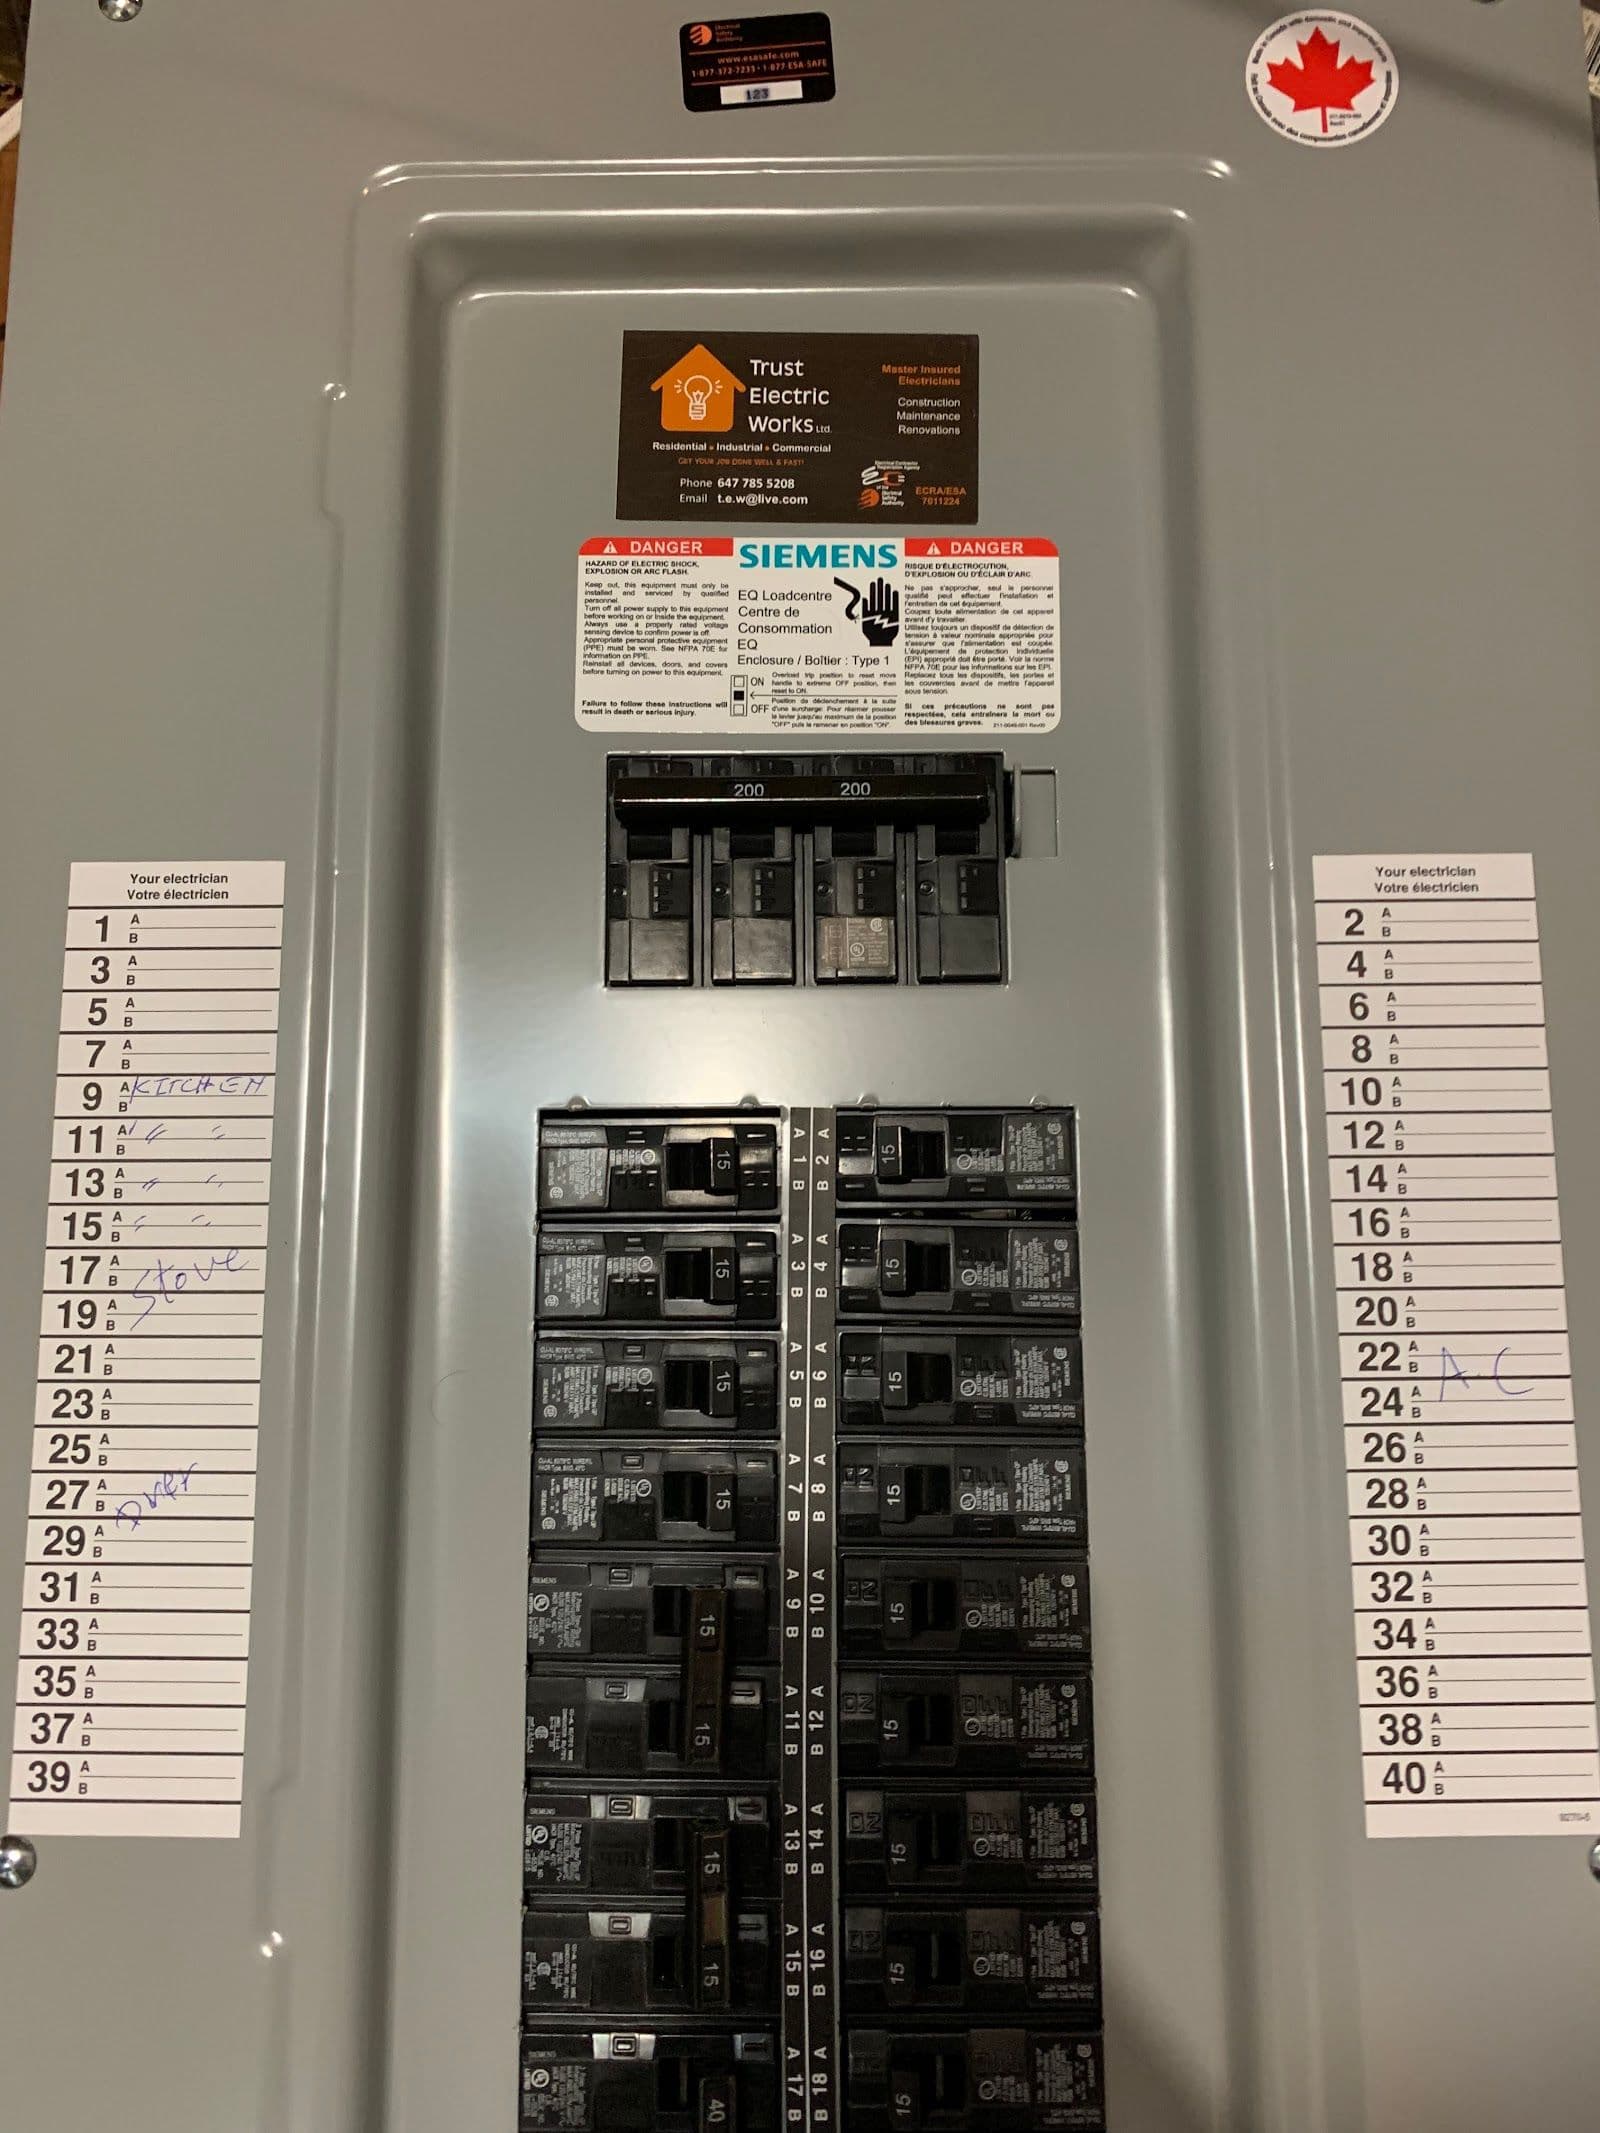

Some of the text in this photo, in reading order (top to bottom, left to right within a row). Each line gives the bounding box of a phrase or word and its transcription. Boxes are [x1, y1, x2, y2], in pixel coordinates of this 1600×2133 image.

[717, 50, 799, 64] www.esasafe.com
[746, 89, 769, 100] 123
[750, 359, 804, 376] Trust
[882, 364, 961, 374] Master Insured
[898, 376, 961, 386] Electricians
[750, 387, 830, 405] Electric
[898, 397, 961, 408] Construction
[748, 415, 832, 434] Works Ltd.
[897, 411, 961, 421] Maintenance
[898, 425, 961, 435] Renovations
[652, 442, 831, 453] Residential Industrial Commercial
[680, 477, 795, 489] Phone 647 785 5208
[915, 486, 967, 496] ECRA/ESA
[679, 493, 808, 507] Email t.e.w@live.com
[630, 541, 703, 554] DANGER
[739, 544, 898, 569] SIEMENS
[950, 541, 1024, 555] DANGER
[970, 570, 1006, 578] D'ÉCLAIR
[738, 591, 832, 602] EQ Loadcentre
[738, 606, 800, 617] Centre de
[738, 623, 832, 634] Consommation
[737, 639, 758, 651] EQ
[737, 655, 890, 668] Enclosure Boîtier Type 1
[751, 677, 765, 687] ON
[674, 709, 696, 717] injury.
[751, 705, 769, 713] OFF
[734, 782, 871, 798] 200 200
[130, 873, 229, 884] Your electrician
[1375, 866, 1476, 877] Your electrician
[127, 889, 229, 900] Votre électricien
[1374, 882, 1479, 893] Votre électricien
[96, 916, 108, 942] 1
[1345, 909, 1364, 936] 2
[91, 956, 109, 984] 3
[1347, 951, 1366, 977] 4
[88, 998, 107, 1025] 5
[1350, 993, 1369, 1020] 6
[87, 1041, 105, 1067] 7
[1352, 1035, 1371, 1063] 8
[83, 1082, 102, 1110] 9
[1341, 1078, 1381, 1105] 10
[69, 1126, 102, 1153] 11
[1344, 1121, 1384, 1149] 12
[716, 1150, 731, 1170] 15
[881, 1144, 895, 1164] 15
[66, 1168, 104, 1197] 13
[1347, 1165, 1387, 1192] 14
[64, 1212, 101, 1240] 15
[1349, 1208, 1389, 1237] 16
[61, 1256, 100, 1284] 17
[716, 1259, 730, 1279] 15
[885, 1259, 900, 1278] 15
[1352, 1252, 1392, 1281] 18
[58, 1300, 96, 1329] 19
[1356, 1297, 1397, 1326] 20
[55, 1345, 91, 1373] 21
[1359, 1342, 1401, 1371] 22
[716, 1371, 731, 1392] 15
[790, 1370, 804, 1381] 5
[812, 1370, 827, 1381] 6
[888, 1371, 902, 1392] 15
[52, 1389, 93, 1419] 23
[1361, 1387, 1403, 1416] 24
[49, 1434, 90, 1464] 25
[1364, 1432, 1405, 1462] 26
[46, 1480, 89, 1509] 27
[788, 1483, 803, 1494] 7
[811, 1483, 826, 1493] 8
[886, 1484, 901, 1505] 15
[1367, 1478, 1409, 1508] 28
[716, 1489, 731, 1510] 15
[43, 1526, 85, 1556] 29
[1369, 1525, 1410, 1555] 30
[40, 1572, 77, 1602] 31
[1371, 1571, 1414, 1602] 32
[786, 1598, 801, 1610] 9
[809, 1593, 825, 1614] 10
[37, 1619, 78, 1649] 33
[1374, 1619, 1416, 1650] 34
[34, 1666, 76, 1697] 35
[1376, 1666, 1419, 1697] 36
[31, 1713, 74, 1744] 37
[785, 1711, 800, 1730] 11
[809, 1710, 824, 1731] 12
[1379, 1714, 1422, 1745] 38
[28, 1761, 70, 1792] 39
[1383, 1762, 1425, 1794] 40
[785, 1832, 801, 1850] 13
[809, 1829, 824, 1849] 14
[786, 1951, 801, 1972] 15
[810, 1949, 825, 1970] 16
[787, 2074, 804, 2096] 17
[812, 2073, 827, 2094] 18
[708, 2099, 725, 2123] 40
